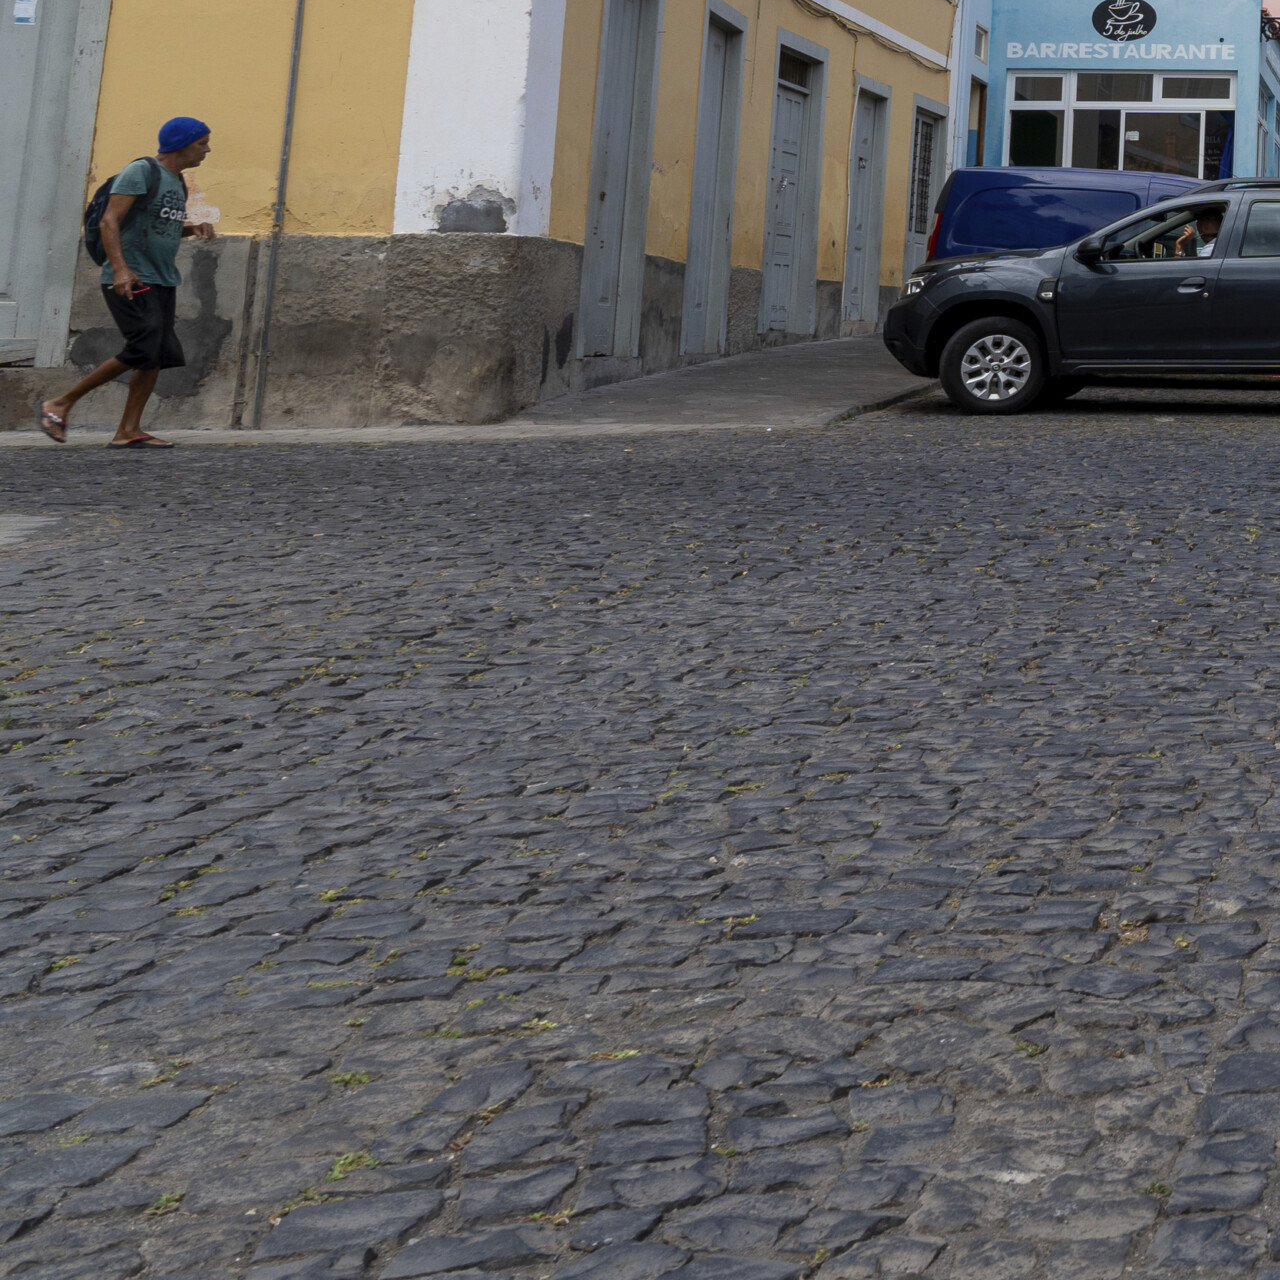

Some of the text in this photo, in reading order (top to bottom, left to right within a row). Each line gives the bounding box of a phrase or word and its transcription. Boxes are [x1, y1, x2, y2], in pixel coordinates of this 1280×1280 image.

[1102, 22, 1148, 43] 5 de julho
[1006, 42, 1235, 60] BAR/RESTAURANTE
